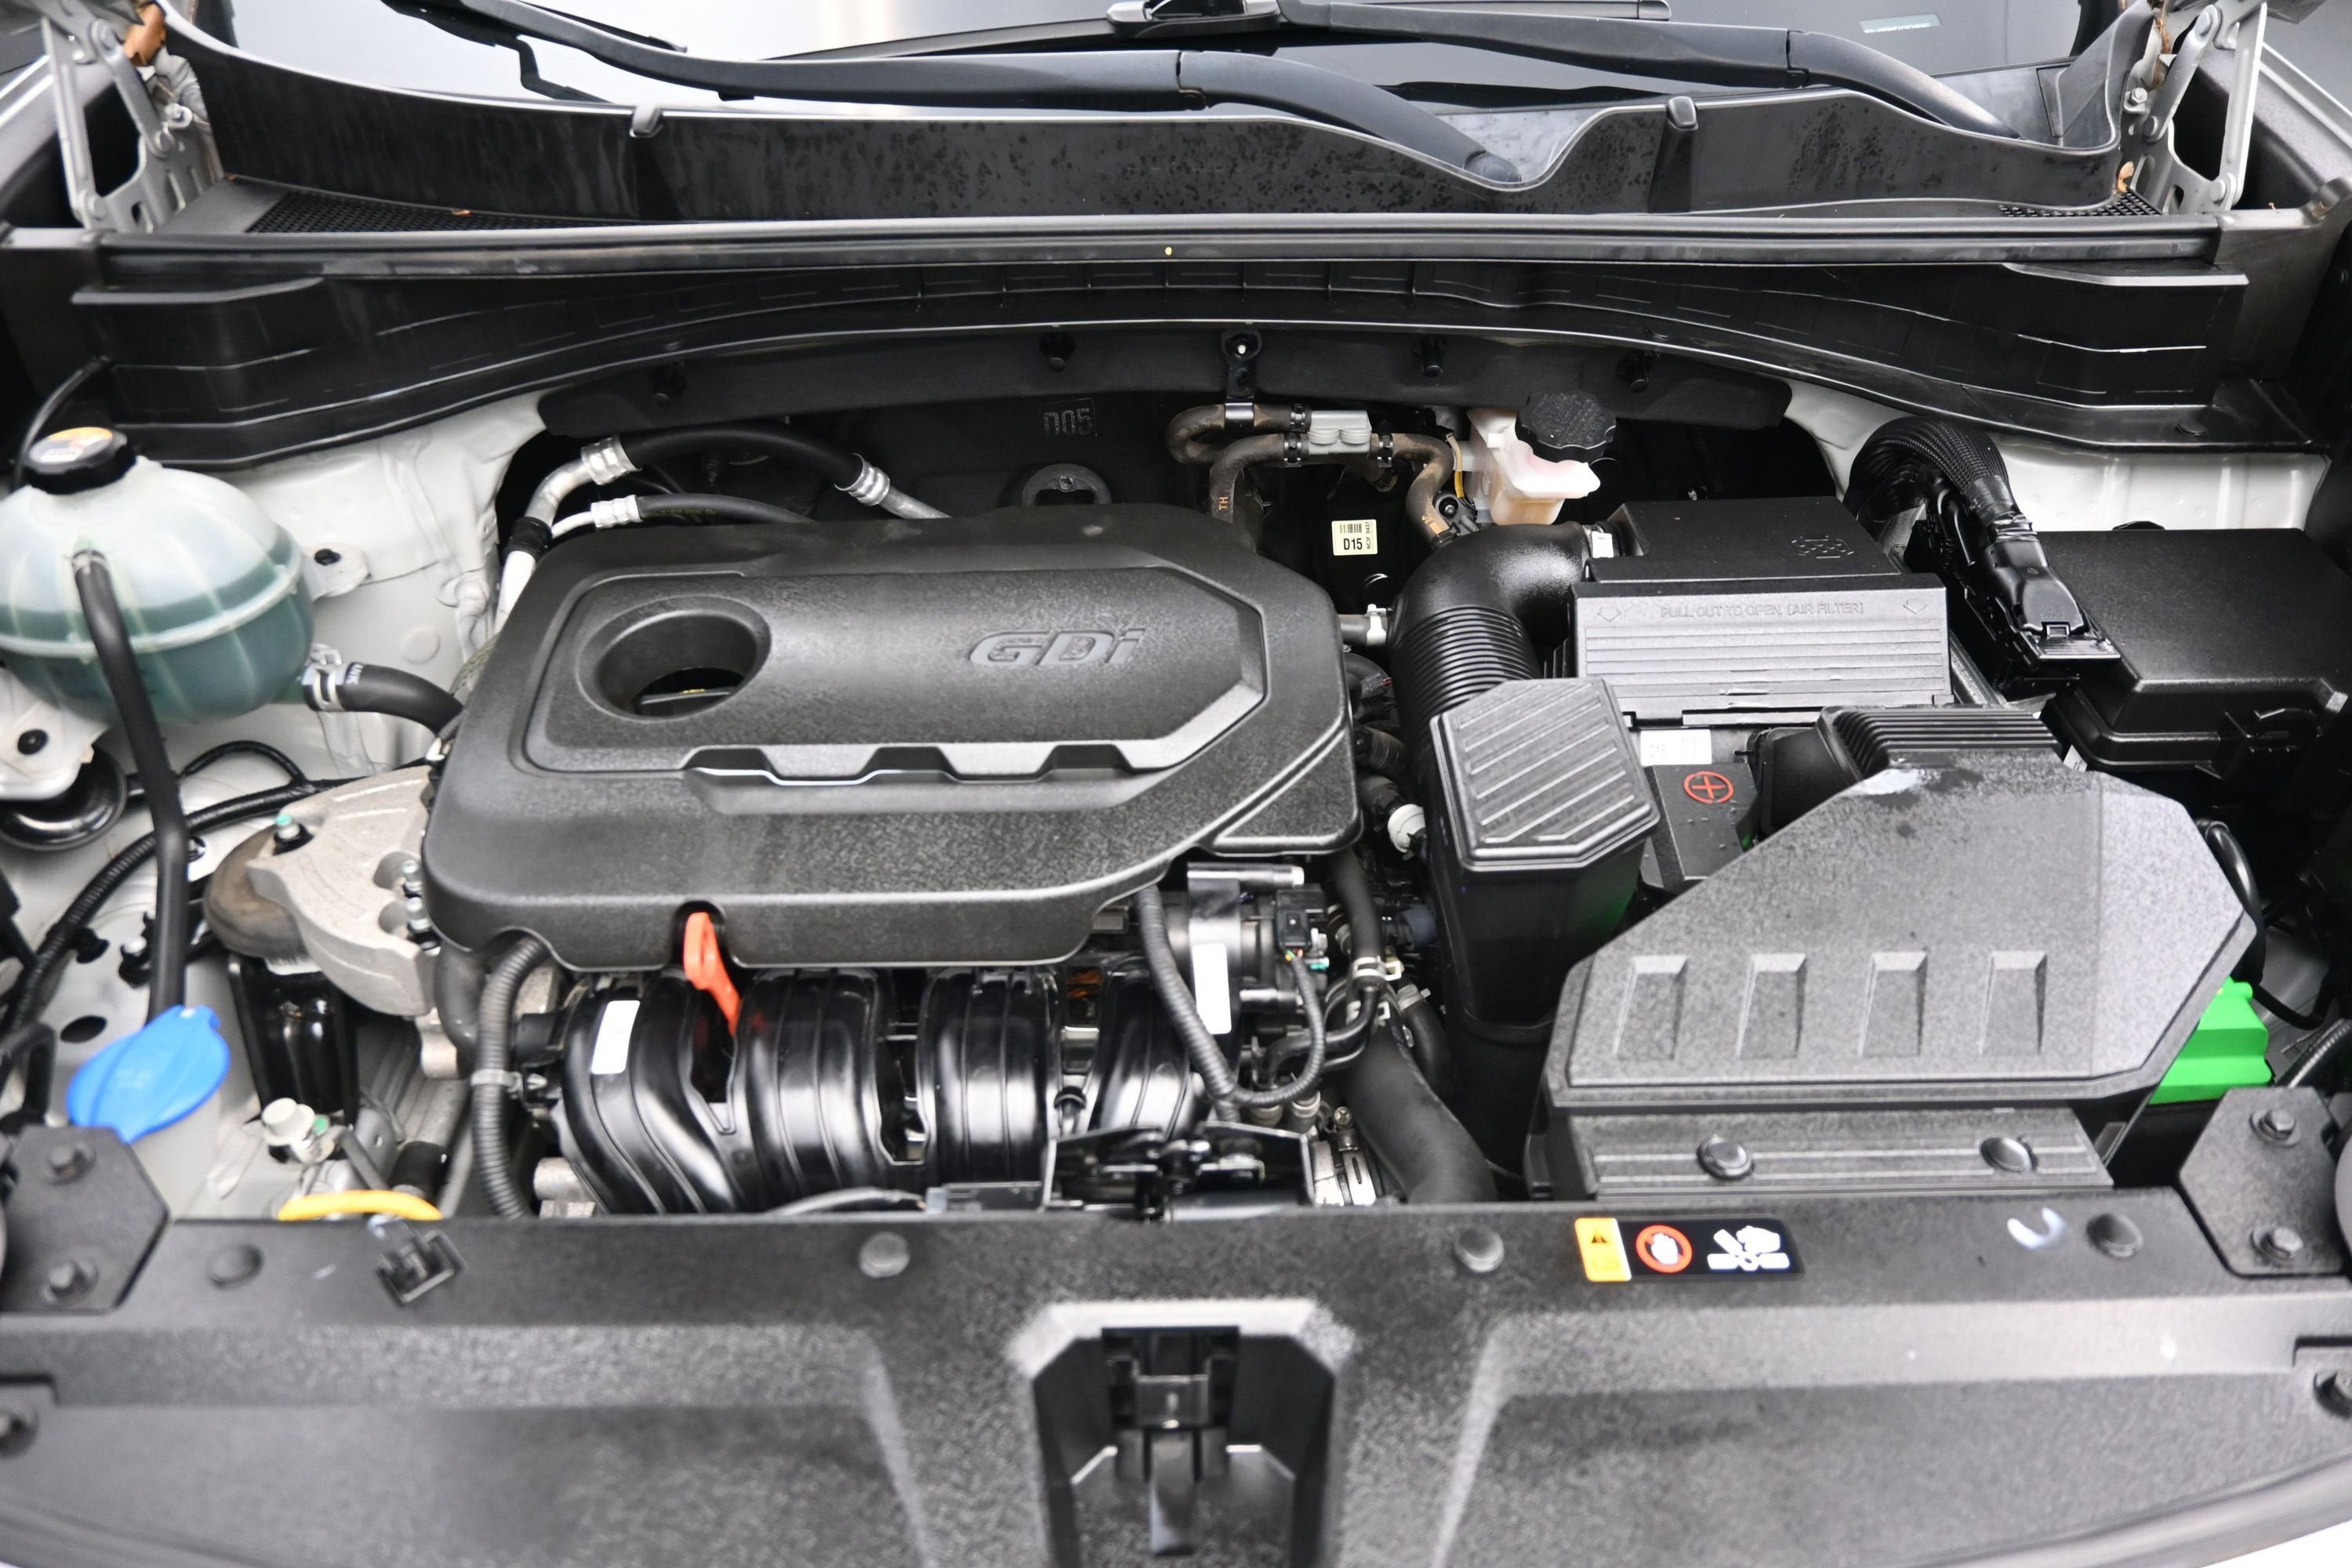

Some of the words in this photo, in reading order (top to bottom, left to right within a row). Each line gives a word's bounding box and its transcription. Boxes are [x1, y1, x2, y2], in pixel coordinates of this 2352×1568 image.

[1218, 496, 1229, 511] TH
[1343, 537, 1363, 550] D15
[1660, 605, 1694, 618] PULL
[1696, 606, 1724, 617] OUT
[1726, 605, 1743, 617] TO
[1745, 604, 1782, 616] OPEN
